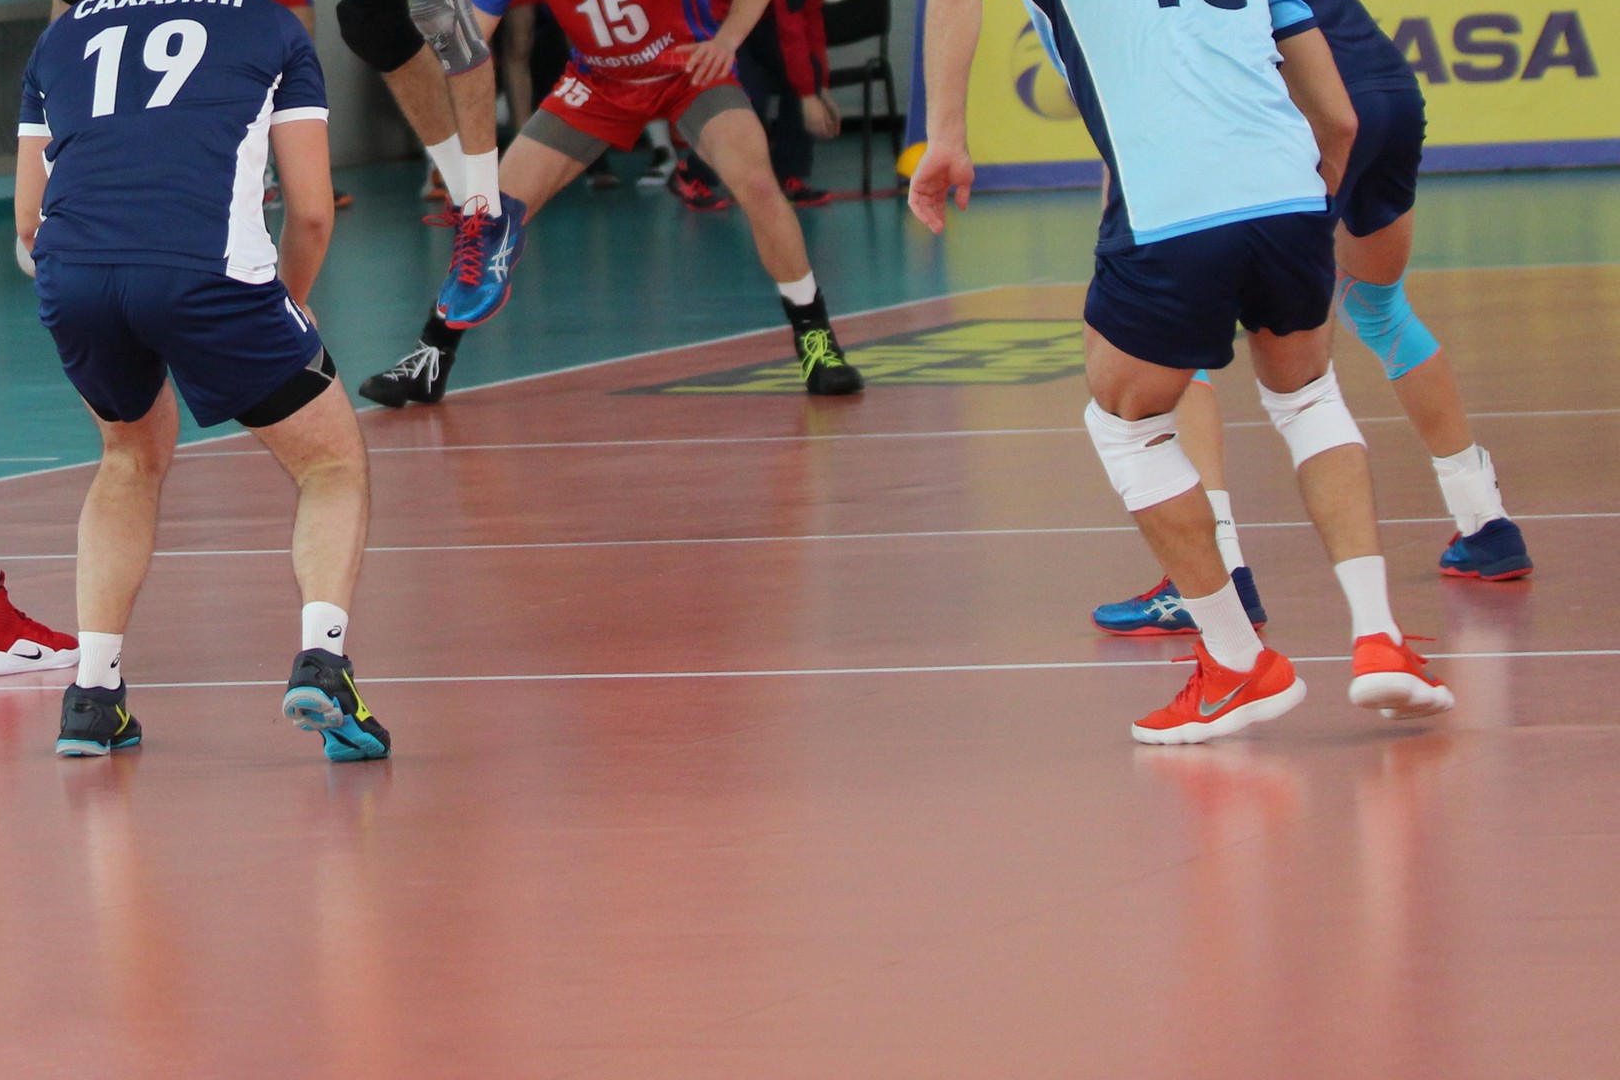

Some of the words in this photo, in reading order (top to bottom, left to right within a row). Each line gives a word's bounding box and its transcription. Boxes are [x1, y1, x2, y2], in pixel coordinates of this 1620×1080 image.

[586, 32, 675, 68] НЕФТЯНИК
[1389, 10, 1600, 85] ASA
[83, 19, 208, 118] 19
[554, 77, 592, 107] 15
[284, 295, 310, 333] 1
